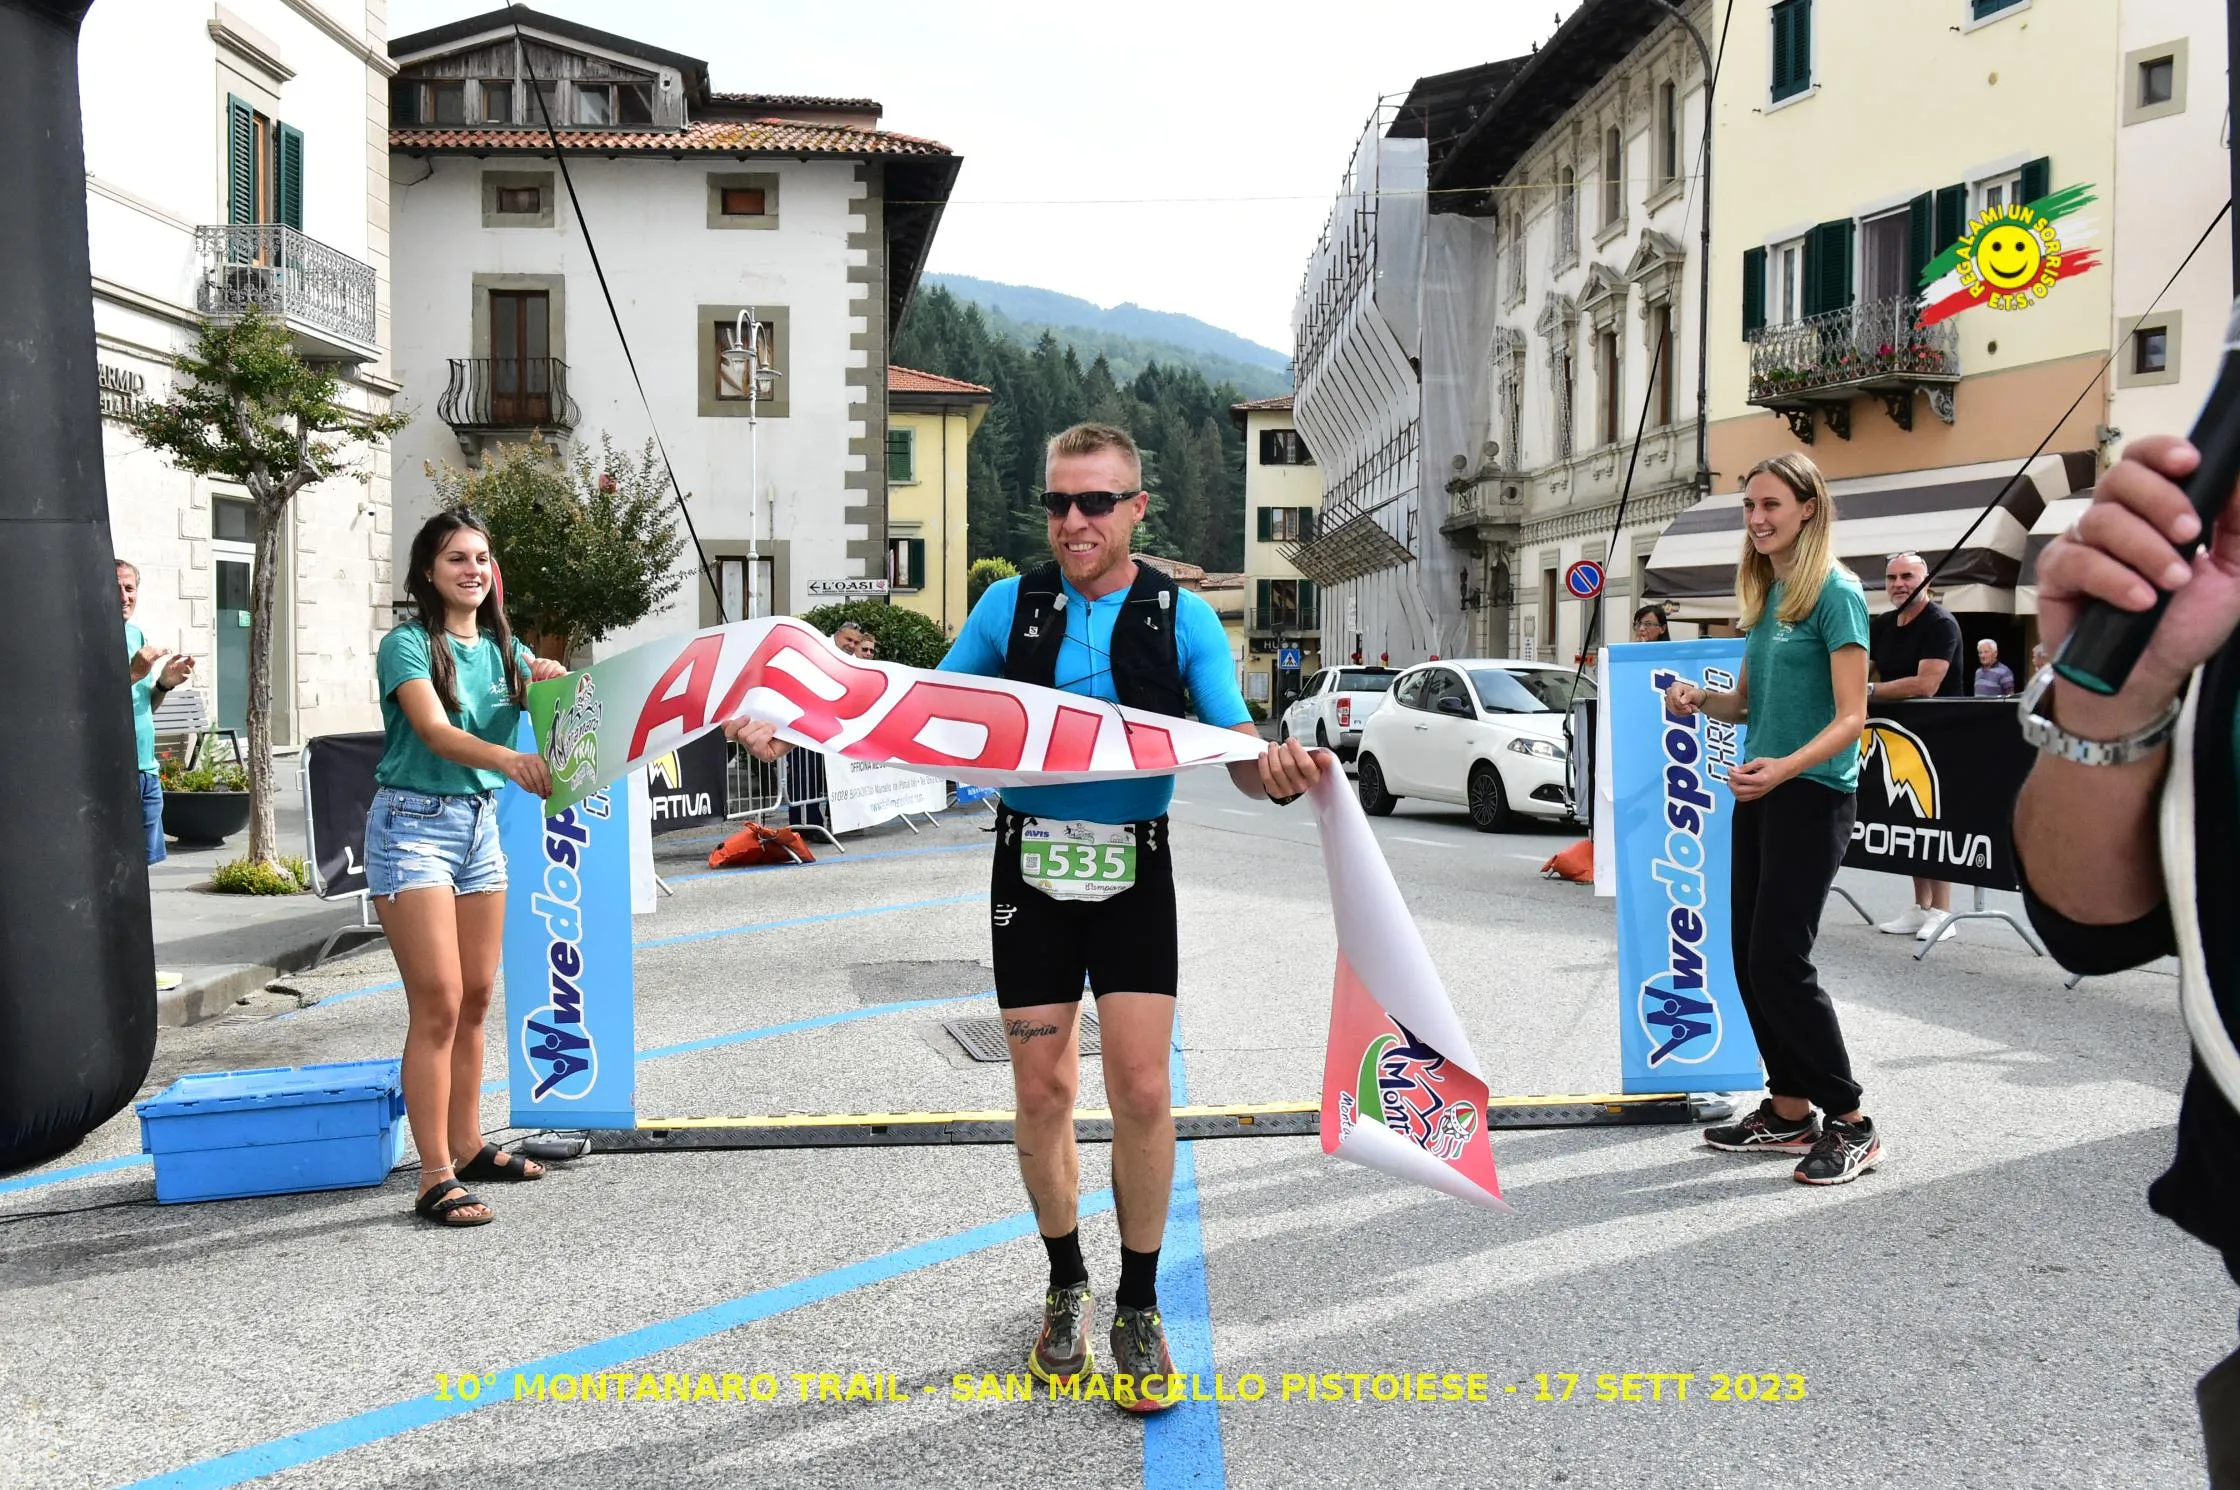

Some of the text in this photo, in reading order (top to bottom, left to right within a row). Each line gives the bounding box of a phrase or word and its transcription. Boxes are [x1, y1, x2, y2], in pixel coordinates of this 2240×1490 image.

[822, 581, 872, 590] L'OASI
[573, 738, 597, 766] TRAIL
[649, 792, 712, 821] RTIVA
[1024, 829, 1050, 838] AVIS
[1850, 821, 1992, 870] PORTIVA
[1046, 844, 1126, 879] 535
[532, 801, 589, 1024] wedosp
[1378, 1062, 1417, 1135] Mont
